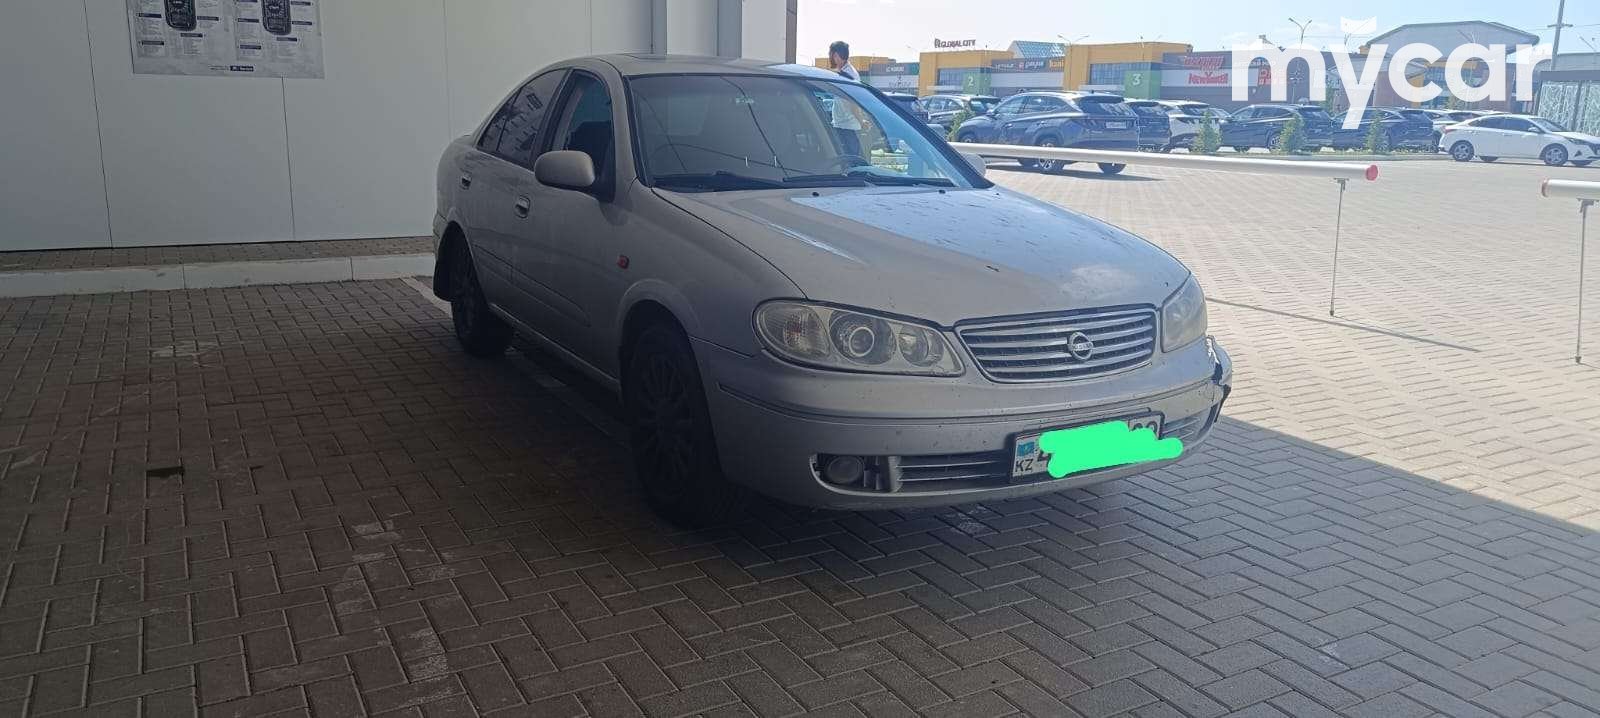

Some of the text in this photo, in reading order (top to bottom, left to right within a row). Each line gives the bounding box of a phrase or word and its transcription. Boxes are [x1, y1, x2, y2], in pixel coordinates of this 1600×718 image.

[962, 39, 977, 47] CITY
[968, 78, 974, 87] 2
[1131, 72, 1142, 86] 3
[1014, 458, 1034, 473] KZ
